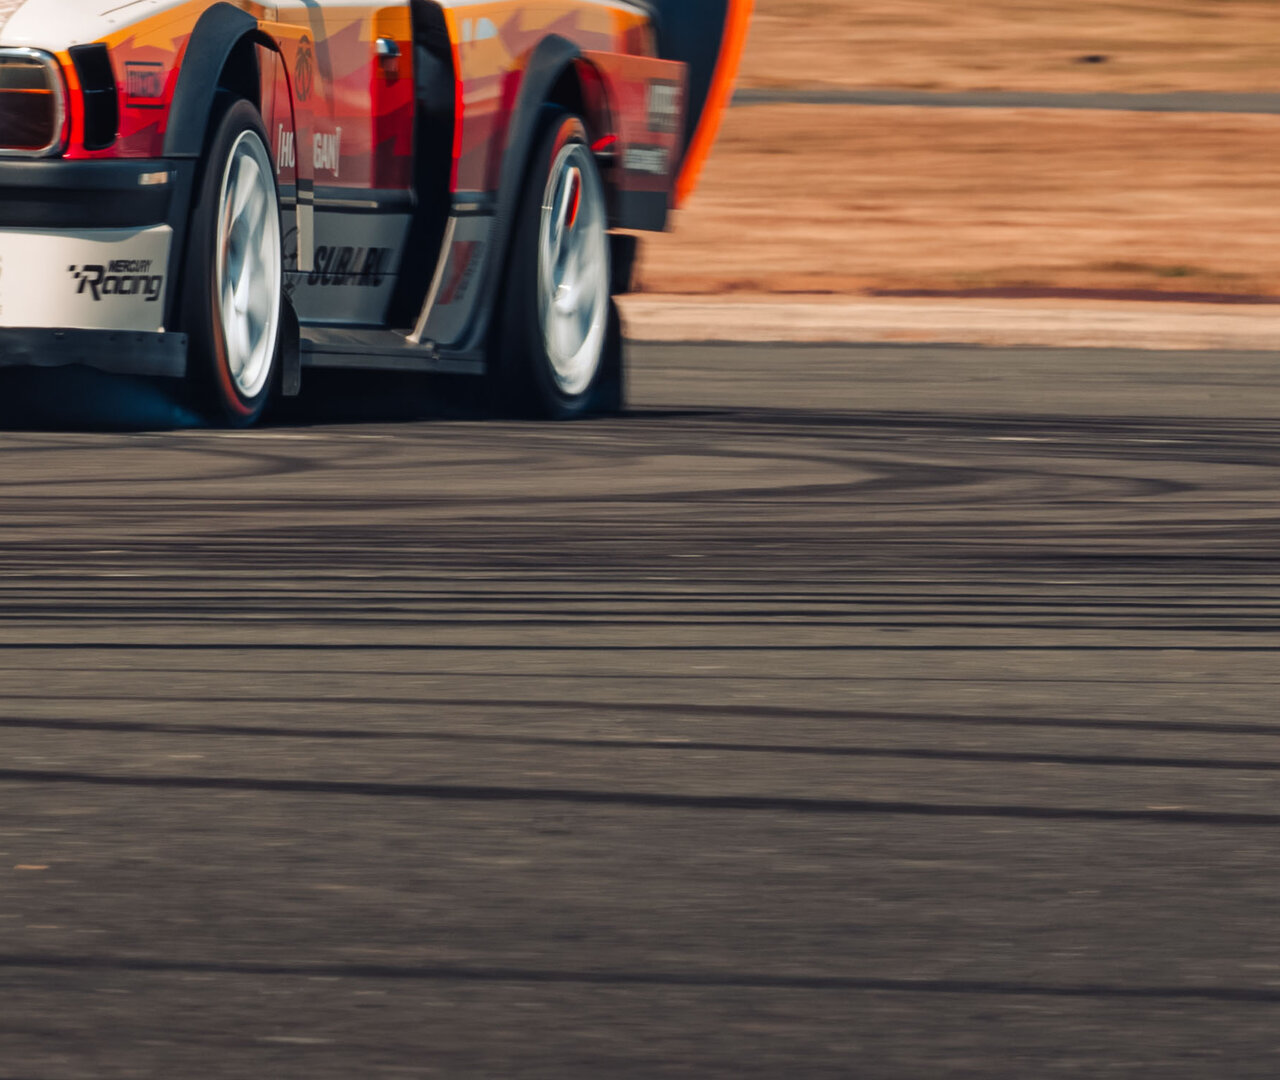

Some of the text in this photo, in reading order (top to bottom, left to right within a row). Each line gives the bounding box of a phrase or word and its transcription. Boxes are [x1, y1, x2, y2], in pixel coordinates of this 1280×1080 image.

[76, 264, 163, 301] Racing
[108, 259, 153, 273] MERCURY
[307, 245, 393, 288] SUBARU
